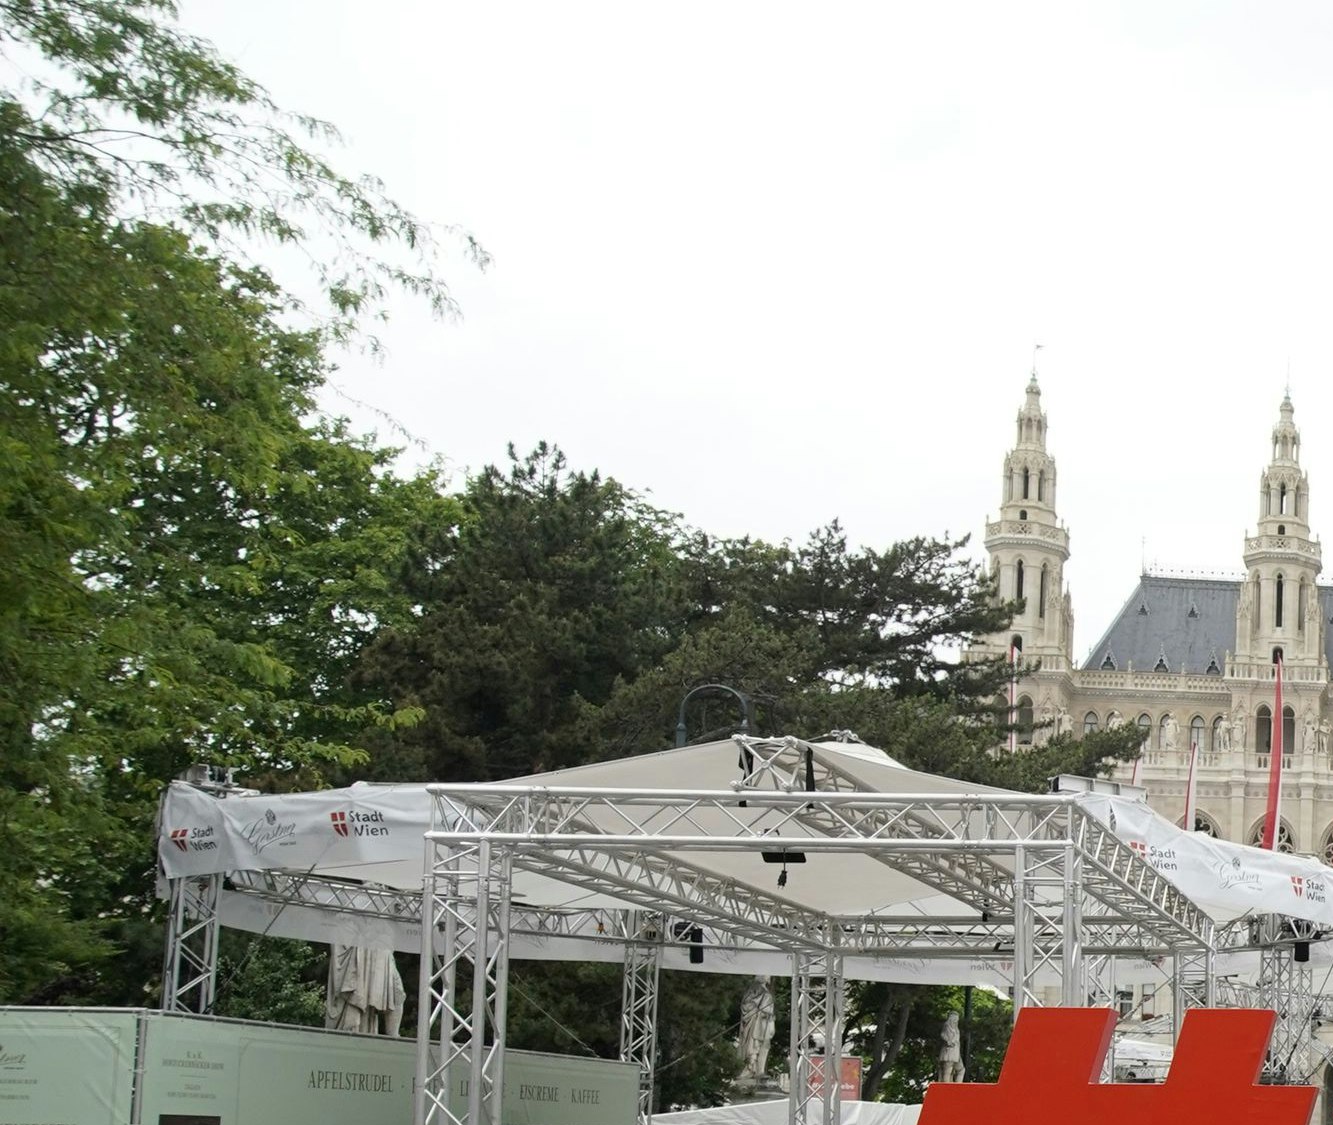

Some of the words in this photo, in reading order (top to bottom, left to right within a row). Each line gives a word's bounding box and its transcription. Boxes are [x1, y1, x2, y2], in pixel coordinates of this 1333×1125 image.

[349, 810, 384, 823] Stadt
[191, 825, 214, 839] Stadt
[190, 840, 217, 852] Wien
[1150, 845, 1176, 859] Stadt
[1150, 858, 1178, 871] Wien
[1306, 879, 1325, 891] Stad
[1306, 890, 1326, 903] Wien
[307, 1070, 393, 1093] APFELSTRUDEL
[519, 1084, 559, 1102] EISCREME
[571, 1088, 600, 1105] KAFFEE
